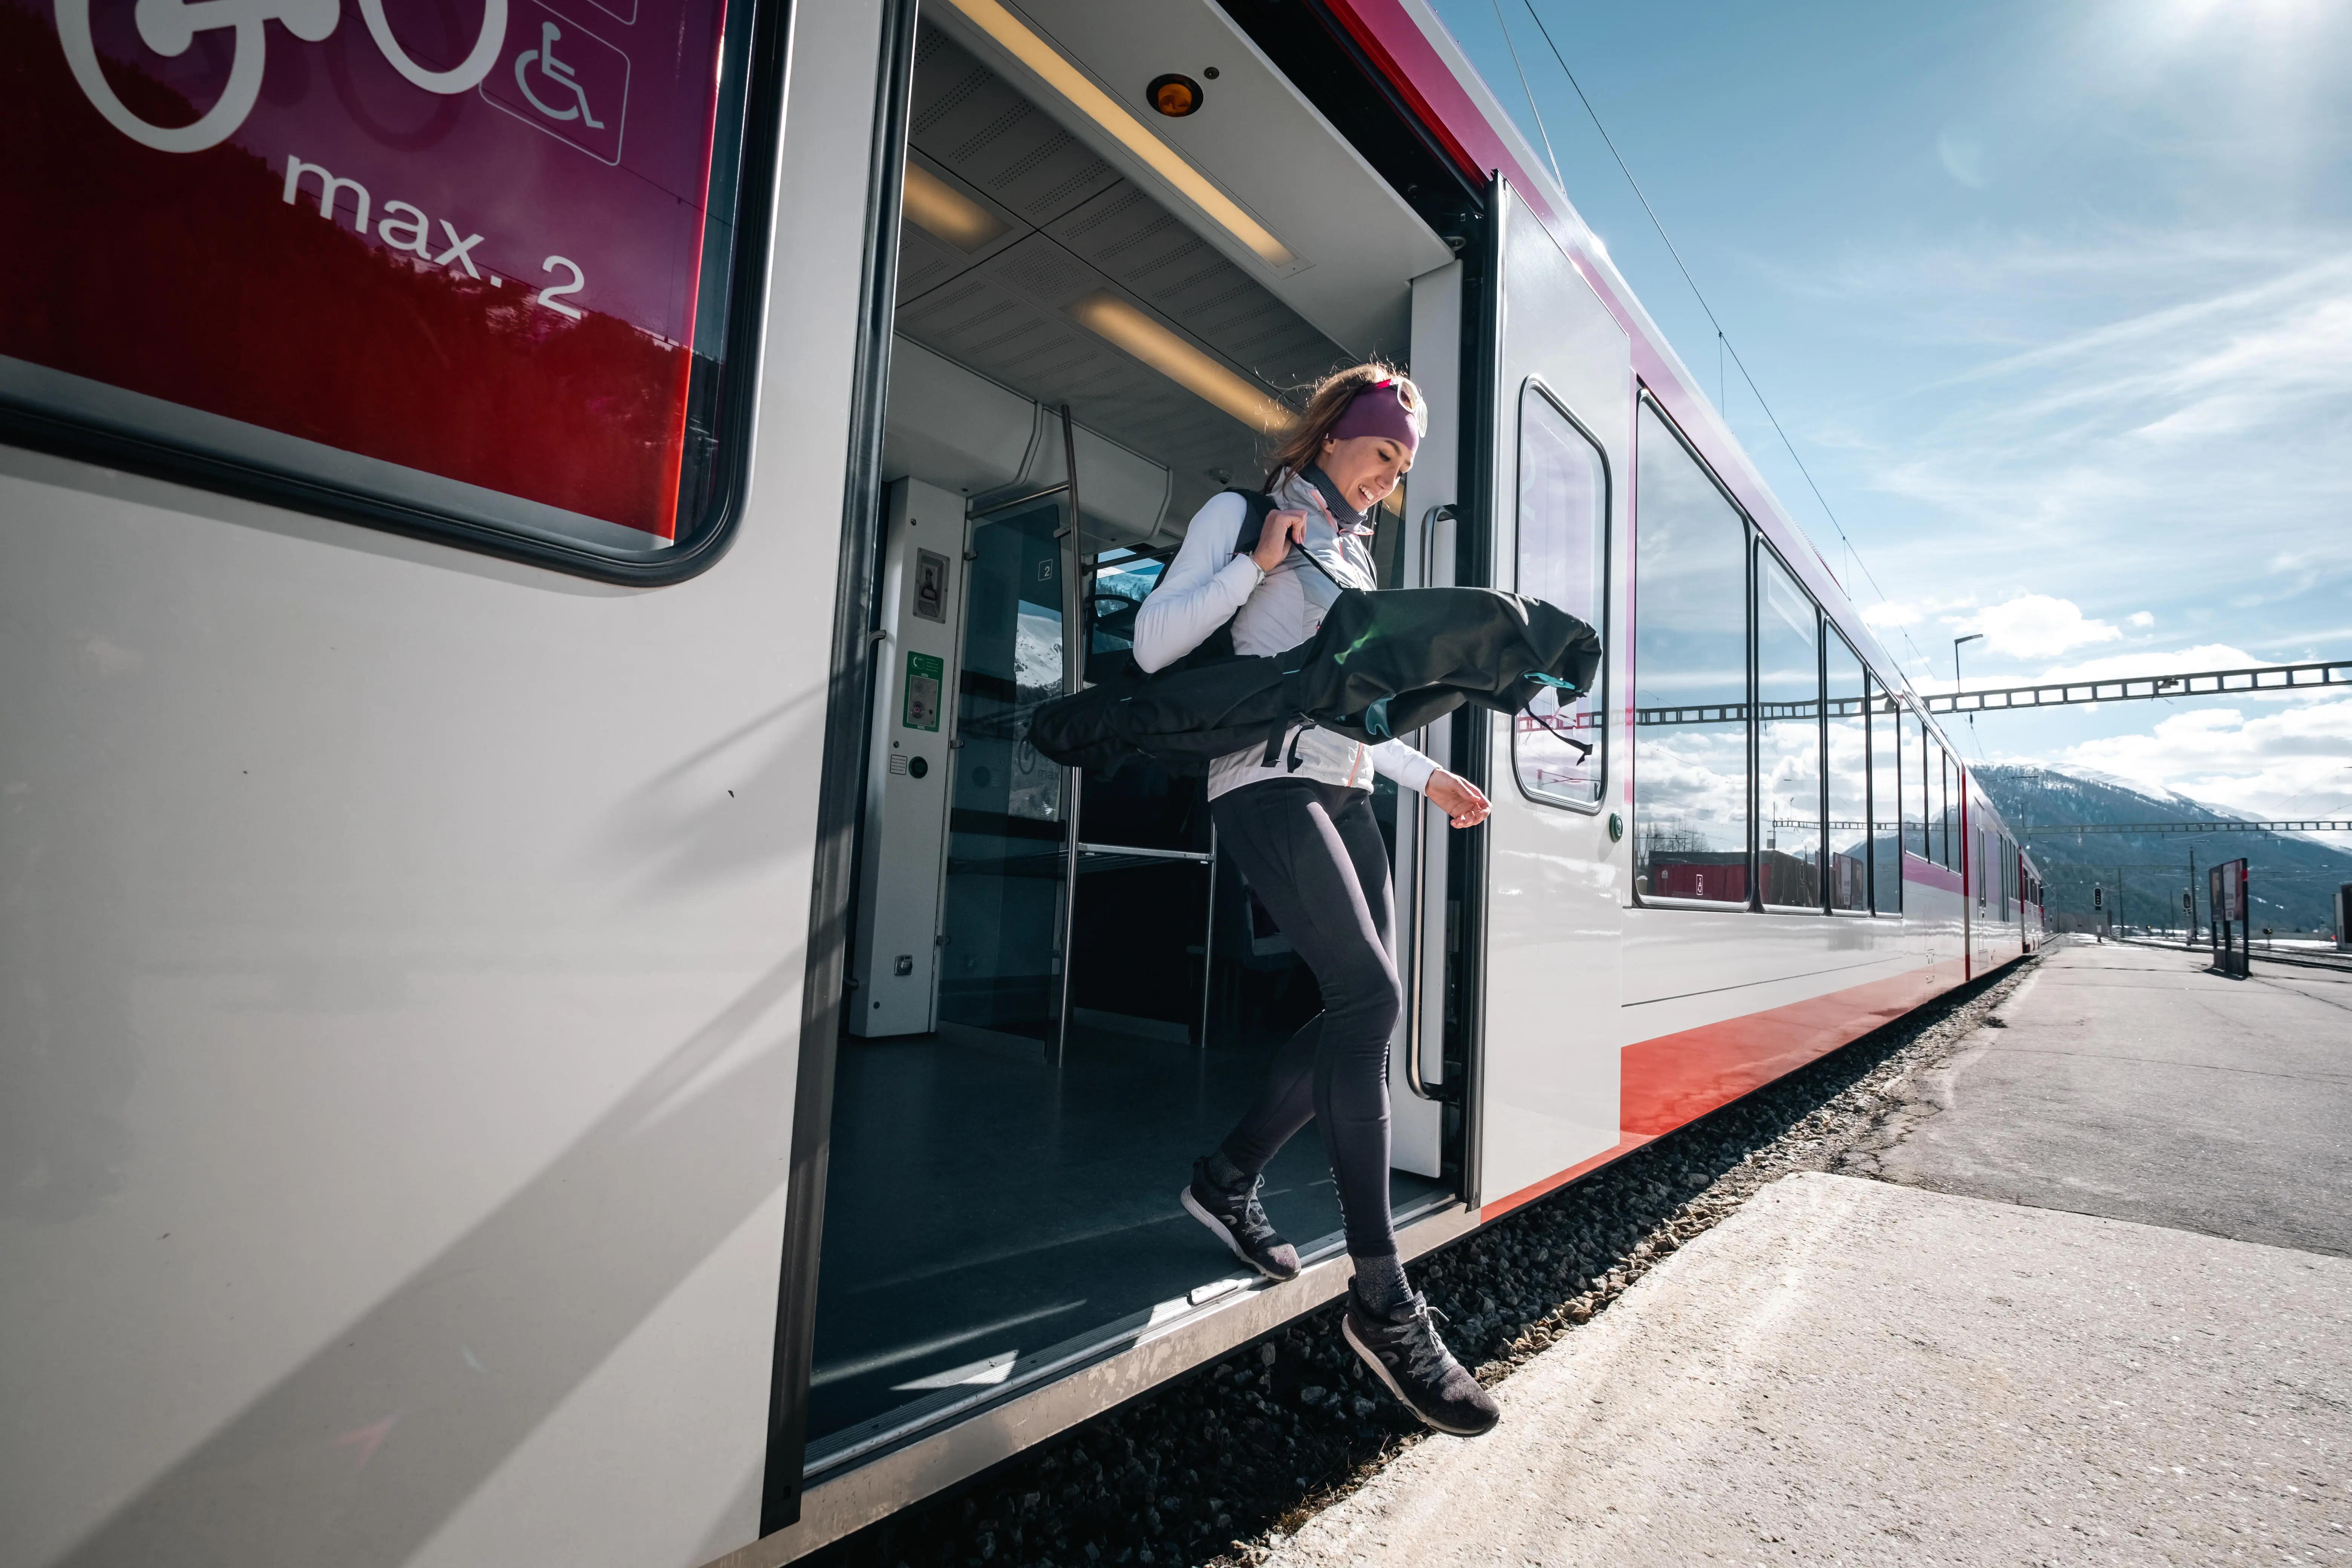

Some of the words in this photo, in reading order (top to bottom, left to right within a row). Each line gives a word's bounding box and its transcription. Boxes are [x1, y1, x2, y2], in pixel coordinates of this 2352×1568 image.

[282, 154, 502, 288] max.
[537, 255, 585, 320] 2
[1044, 566, 1050, 577] 2
